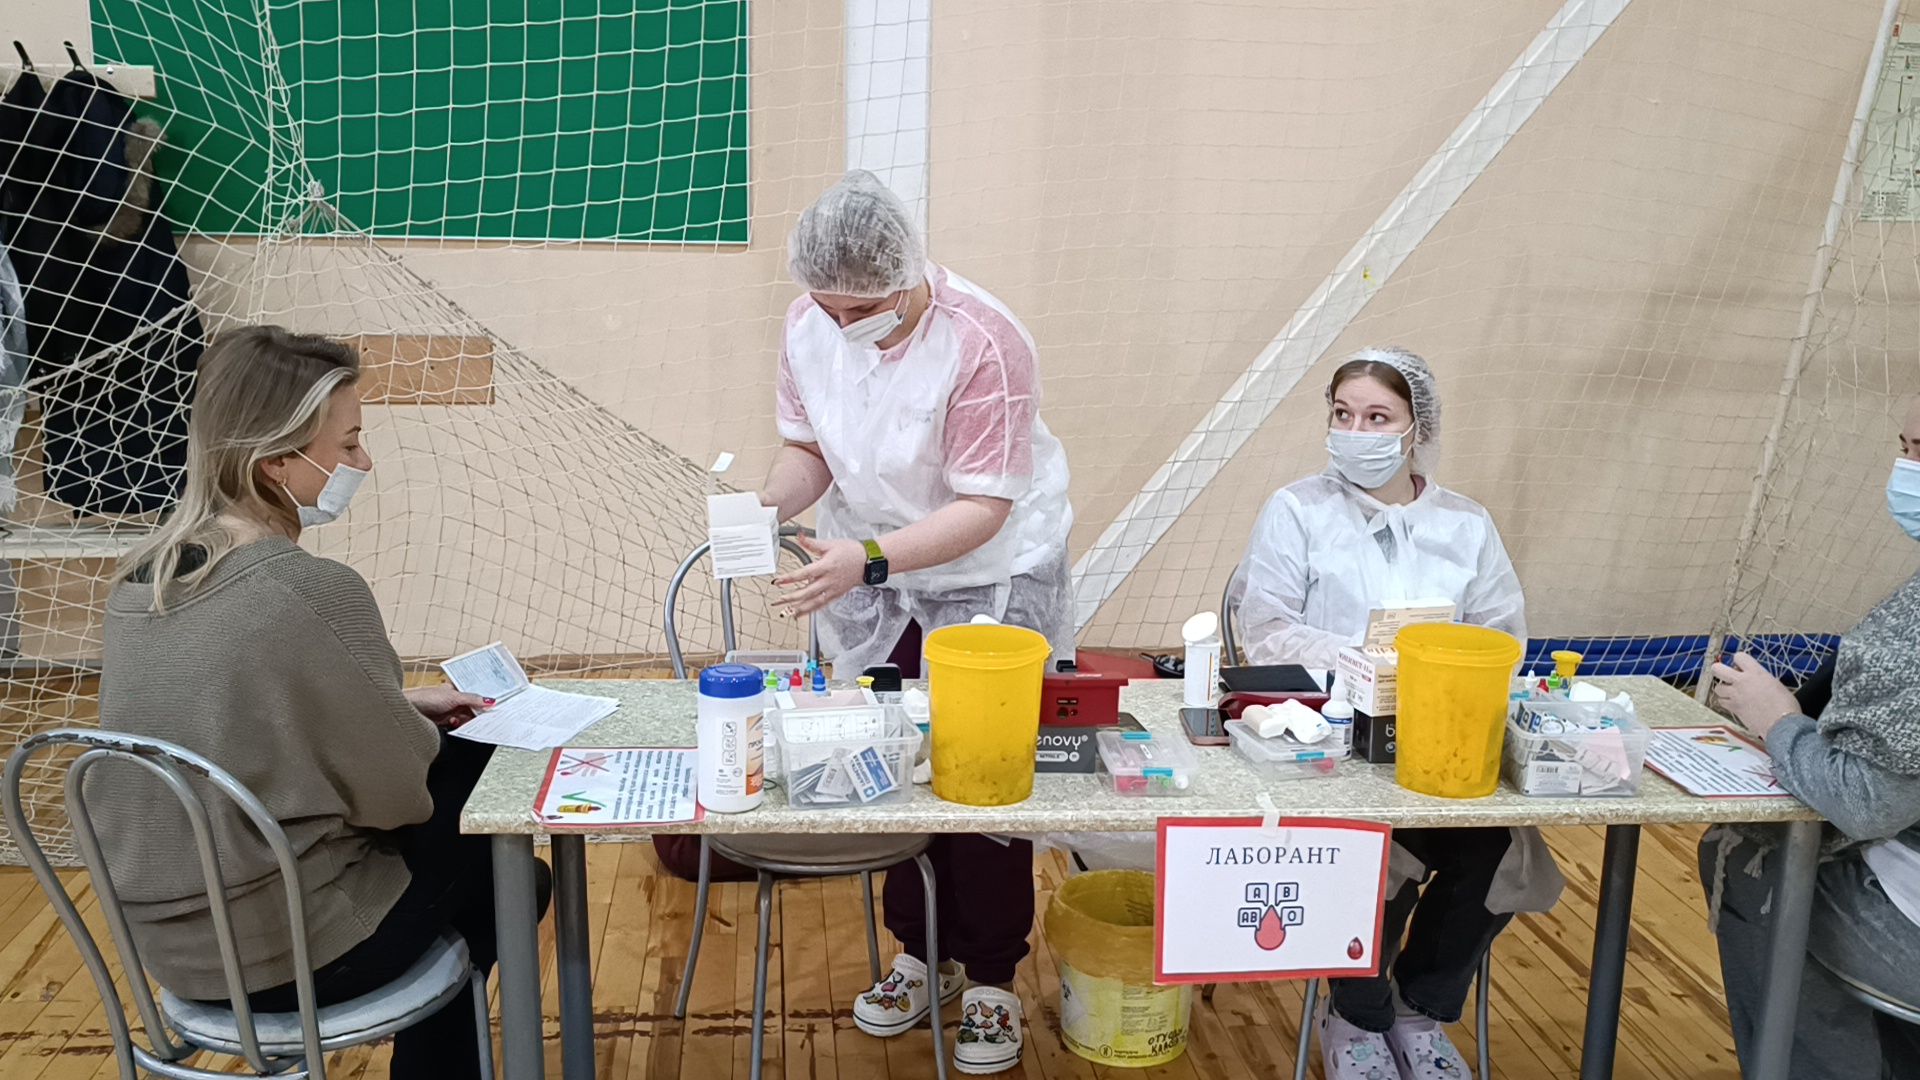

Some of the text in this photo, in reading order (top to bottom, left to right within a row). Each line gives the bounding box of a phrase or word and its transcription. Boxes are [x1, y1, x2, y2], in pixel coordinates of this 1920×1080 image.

[1205, 846, 1341, 865] ЛАБОРАНТ
[1253, 887, 1262, 899] A
[1283, 886, 1291, 898] B
[1241, 911, 1258, 923] AB
